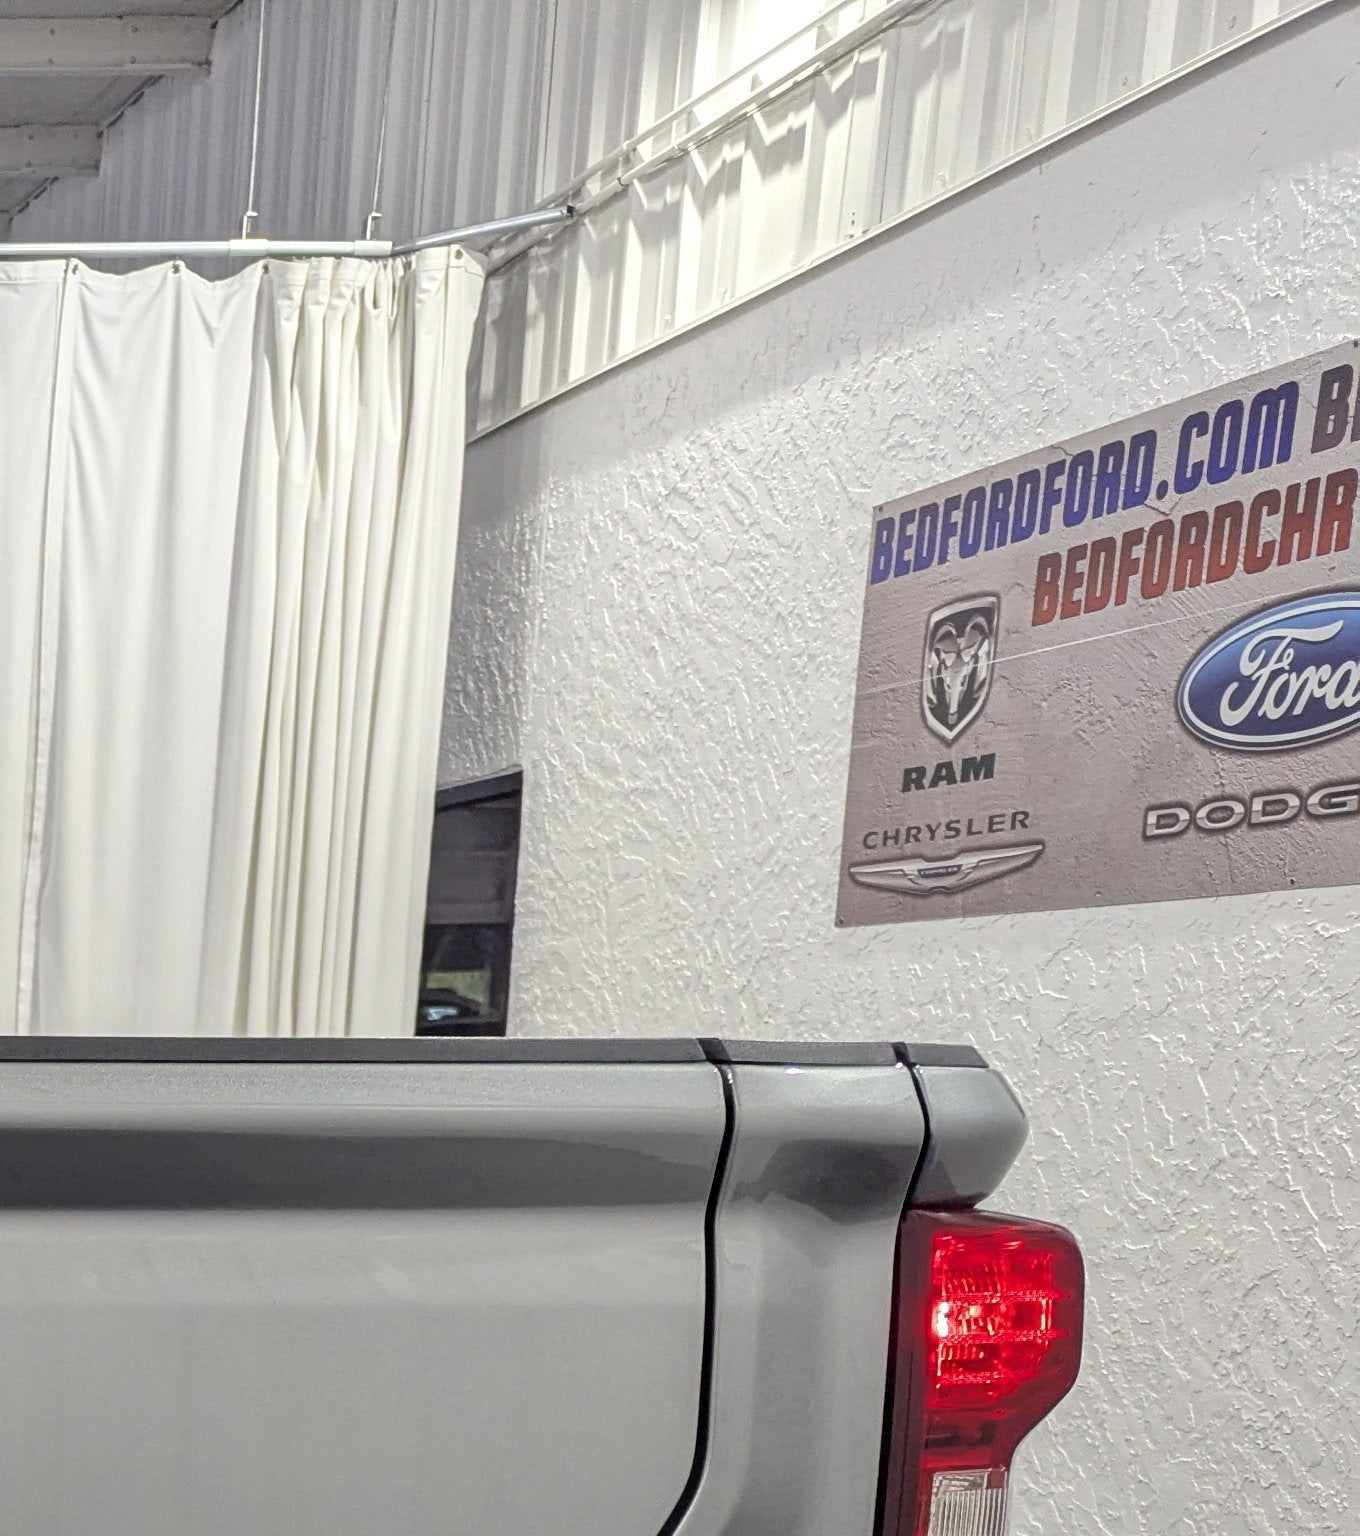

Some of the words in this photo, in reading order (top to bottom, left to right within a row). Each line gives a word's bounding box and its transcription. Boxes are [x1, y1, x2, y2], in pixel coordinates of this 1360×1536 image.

[870, 380, 1300, 586] BEDFORDFORD.COM
[1310, 363, 1360, 455] B
[1031, 467, 1359, 627] BEDFORDCHR
[901, 753, 996, 793] RAM
[863, 811, 1030, 849] CHRYSLER
